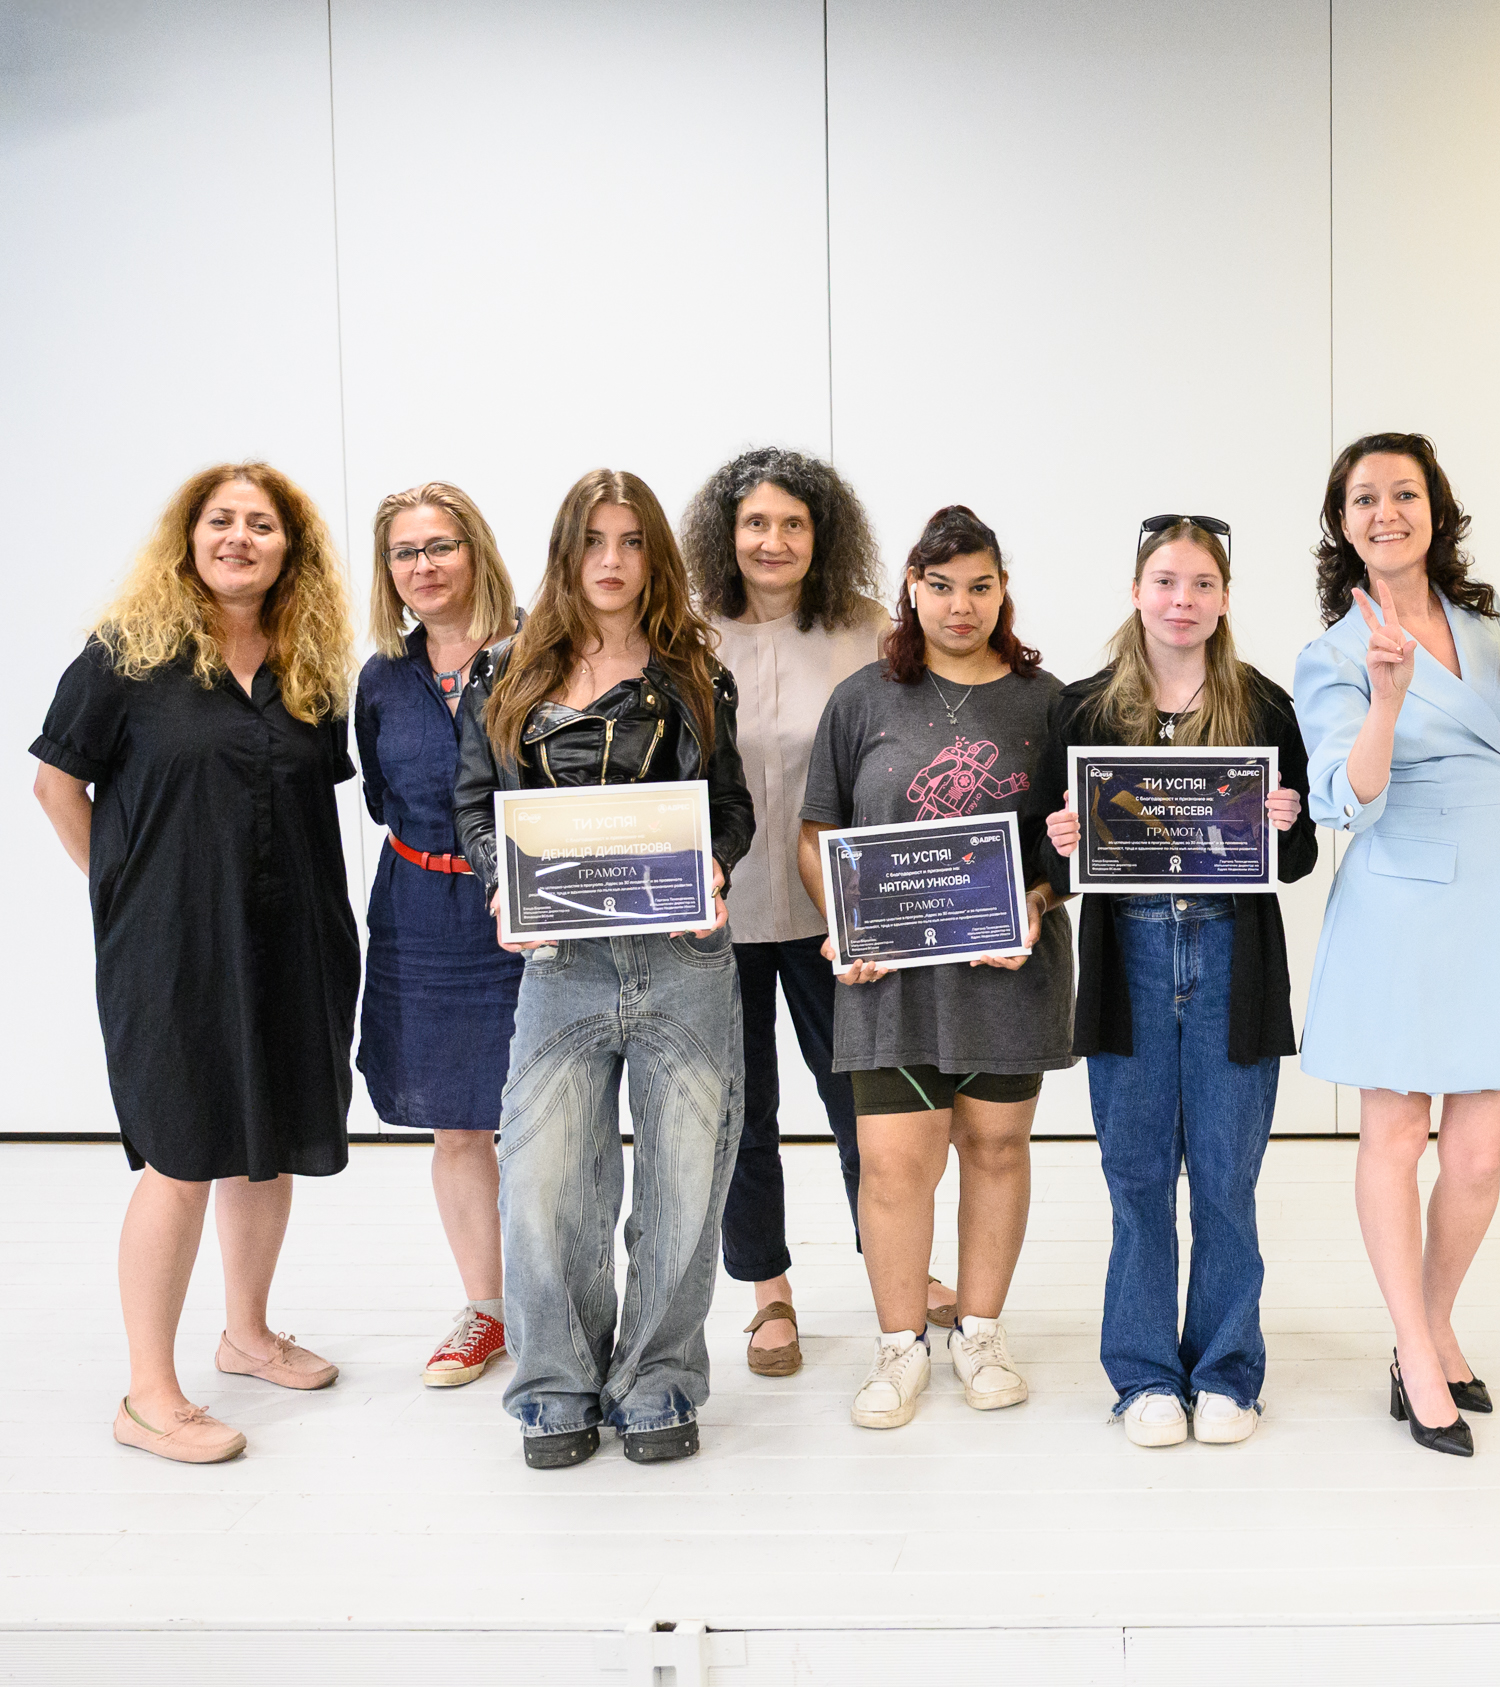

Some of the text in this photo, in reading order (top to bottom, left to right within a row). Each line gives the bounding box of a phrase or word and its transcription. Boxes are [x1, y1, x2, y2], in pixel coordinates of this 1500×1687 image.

[1143, 777, 1206, 789] ТИ УСПЯ!
[965, 792, 982, 815] tray.io
[1140, 805, 1212, 815] ЛИЯ ТАСЕВА
[572, 815, 636, 830] ТИ УСПЯ!
[1146, 826, 1203, 836] ГРАМОТА
[979, 834, 1000, 843] АДРЕС
[541, 841, 671, 860] ДЕНИЦА ДИМИТРОВА
[891, 848, 951, 866] ТИ УСПЯ!
[578, 866, 636, 879] ГРАМОТА
[879, 874, 970, 893] НАТАЛИ УНКОВА
[899, 897, 953, 911] ГРАМОТА
